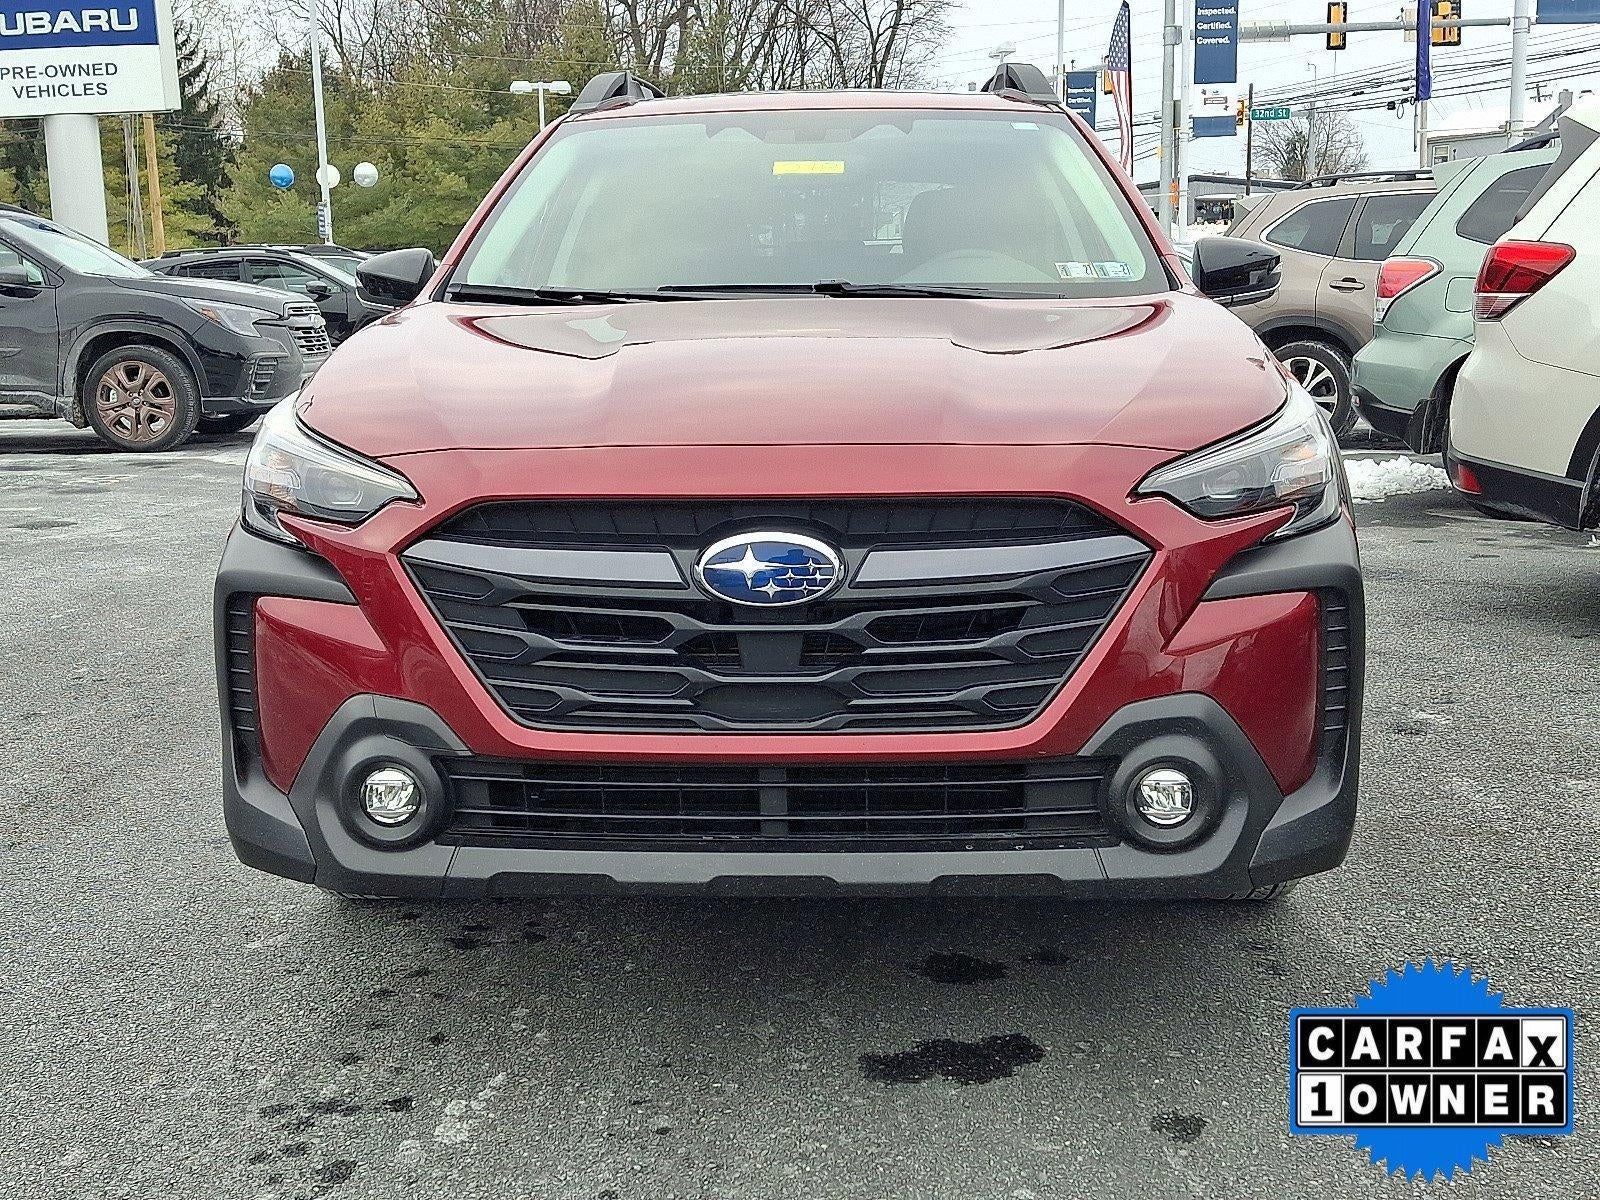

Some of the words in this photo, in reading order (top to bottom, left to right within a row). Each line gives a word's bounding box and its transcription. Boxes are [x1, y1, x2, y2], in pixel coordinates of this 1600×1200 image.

[0, 8, 138, 36] UBARU
[1196, 21, 1232, 30] Certified.
[0, 62, 118, 80] PRE-OWNED
[12, 82, 108, 99] VEHICLES
[1254, 108, 1275, 118] 32nd
[1277, 108, 1287, 117] St
